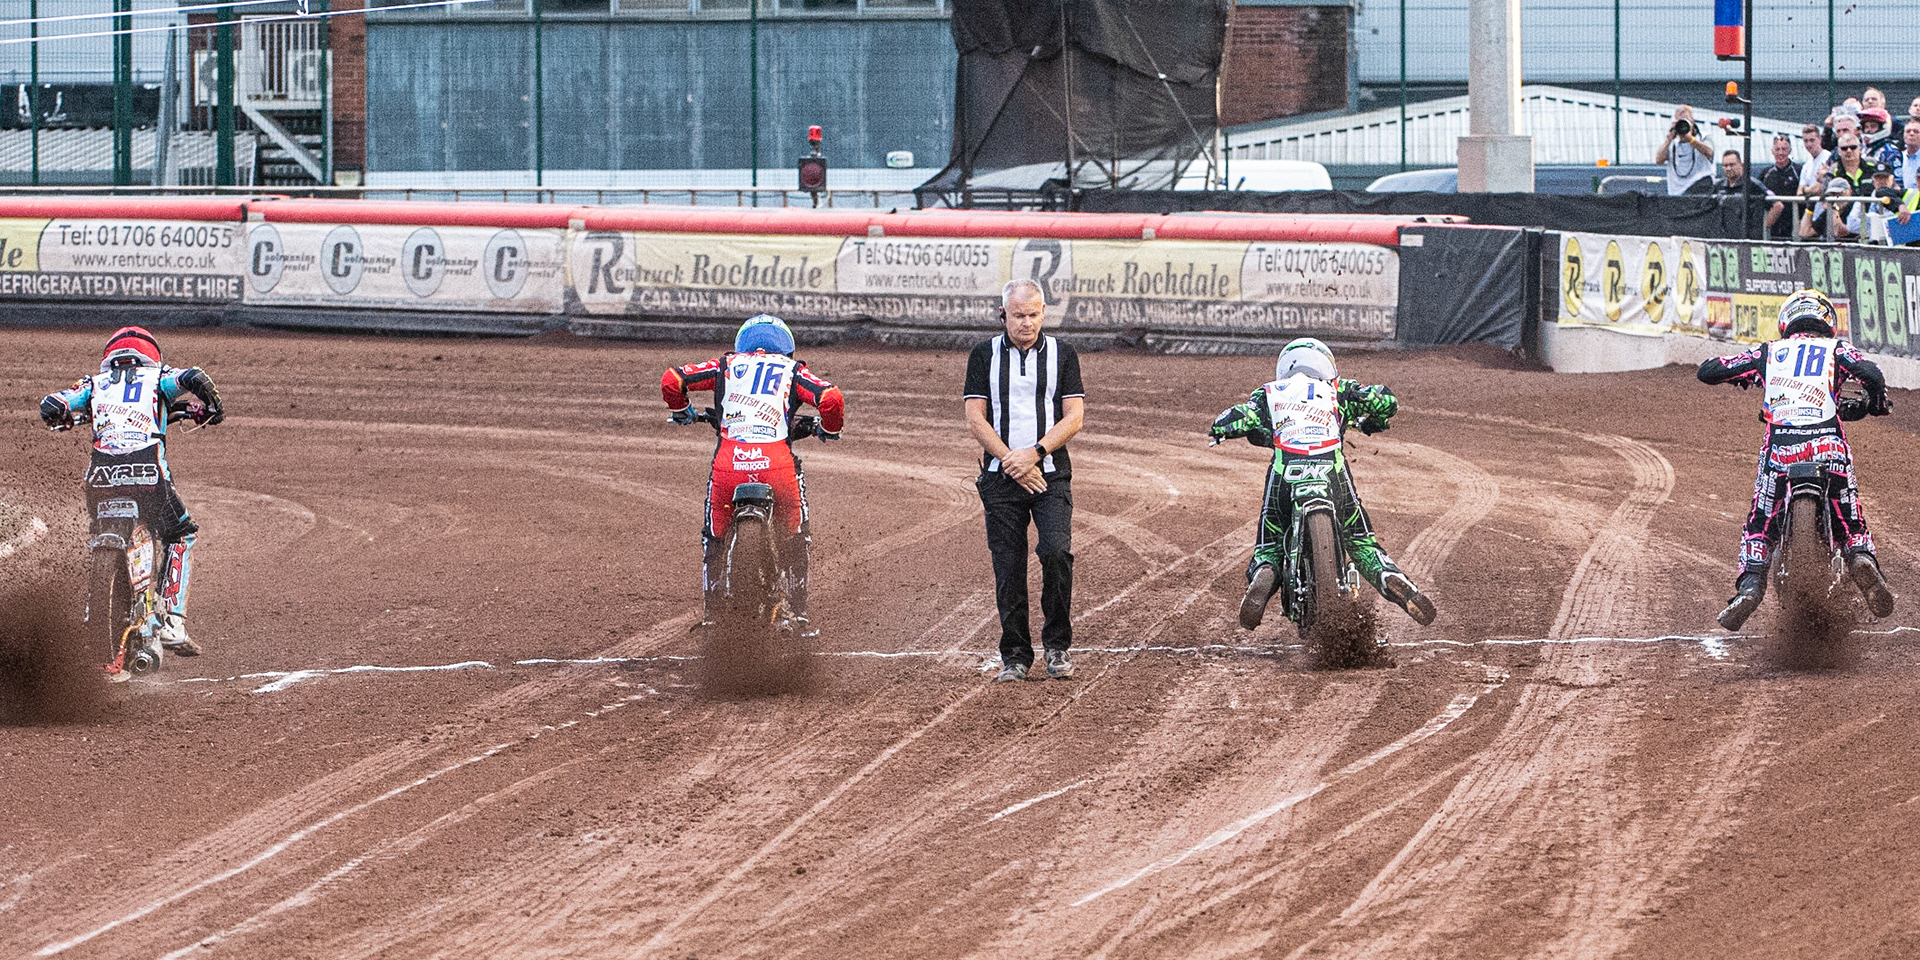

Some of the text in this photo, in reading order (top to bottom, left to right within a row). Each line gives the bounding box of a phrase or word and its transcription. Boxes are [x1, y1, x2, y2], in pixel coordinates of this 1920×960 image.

[58, 224, 233, 248] Tel: 01706 640055
[71, 251, 216, 270] www.rentruck.co.uk
[854, 241, 990, 267] Tel: 01706 640055
[1256, 248, 1384, 275] Tel: 01706 640055
[691, 254, 822, 288] Rochdale
[865, 272, 978, 290] www.rentruck.co.uk
[1120, 261, 1229, 297] Rochdale
[120, 276, 194, 297] VEHICLE
[196, 279, 239, 298] HIRE
[716, 292, 779, 313] MINIBUS
[794, 295, 903, 317] REFRIGERATED
[906, 297, 961, 318] VEHICLE
[963, 300, 995, 320] HIRE
[1207, 304, 1302, 328] REFRIGERATED
[1302, 307, 1356, 330] VEHICLE
[1360, 310, 1393, 333] HIRE
[1793, 344, 1827, 377] 18
[750, 361, 786, 396] 16
[1769, 376, 1827, 402] BRITISH FINAL
[728, 392, 782, 422] BRITISH FINAL
[1274, 401, 1333, 422] BRITISH FINAL
[1798, 393, 1824, 408] 2019
[97, 403, 152, 427] BRITISH FINAL
[754, 410, 779, 427] 2019
[90, 464, 158, 487] AYRES
[733, 460, 770, 471] TENGTOOLS
[1284, 464, 1333, 482] CWR
